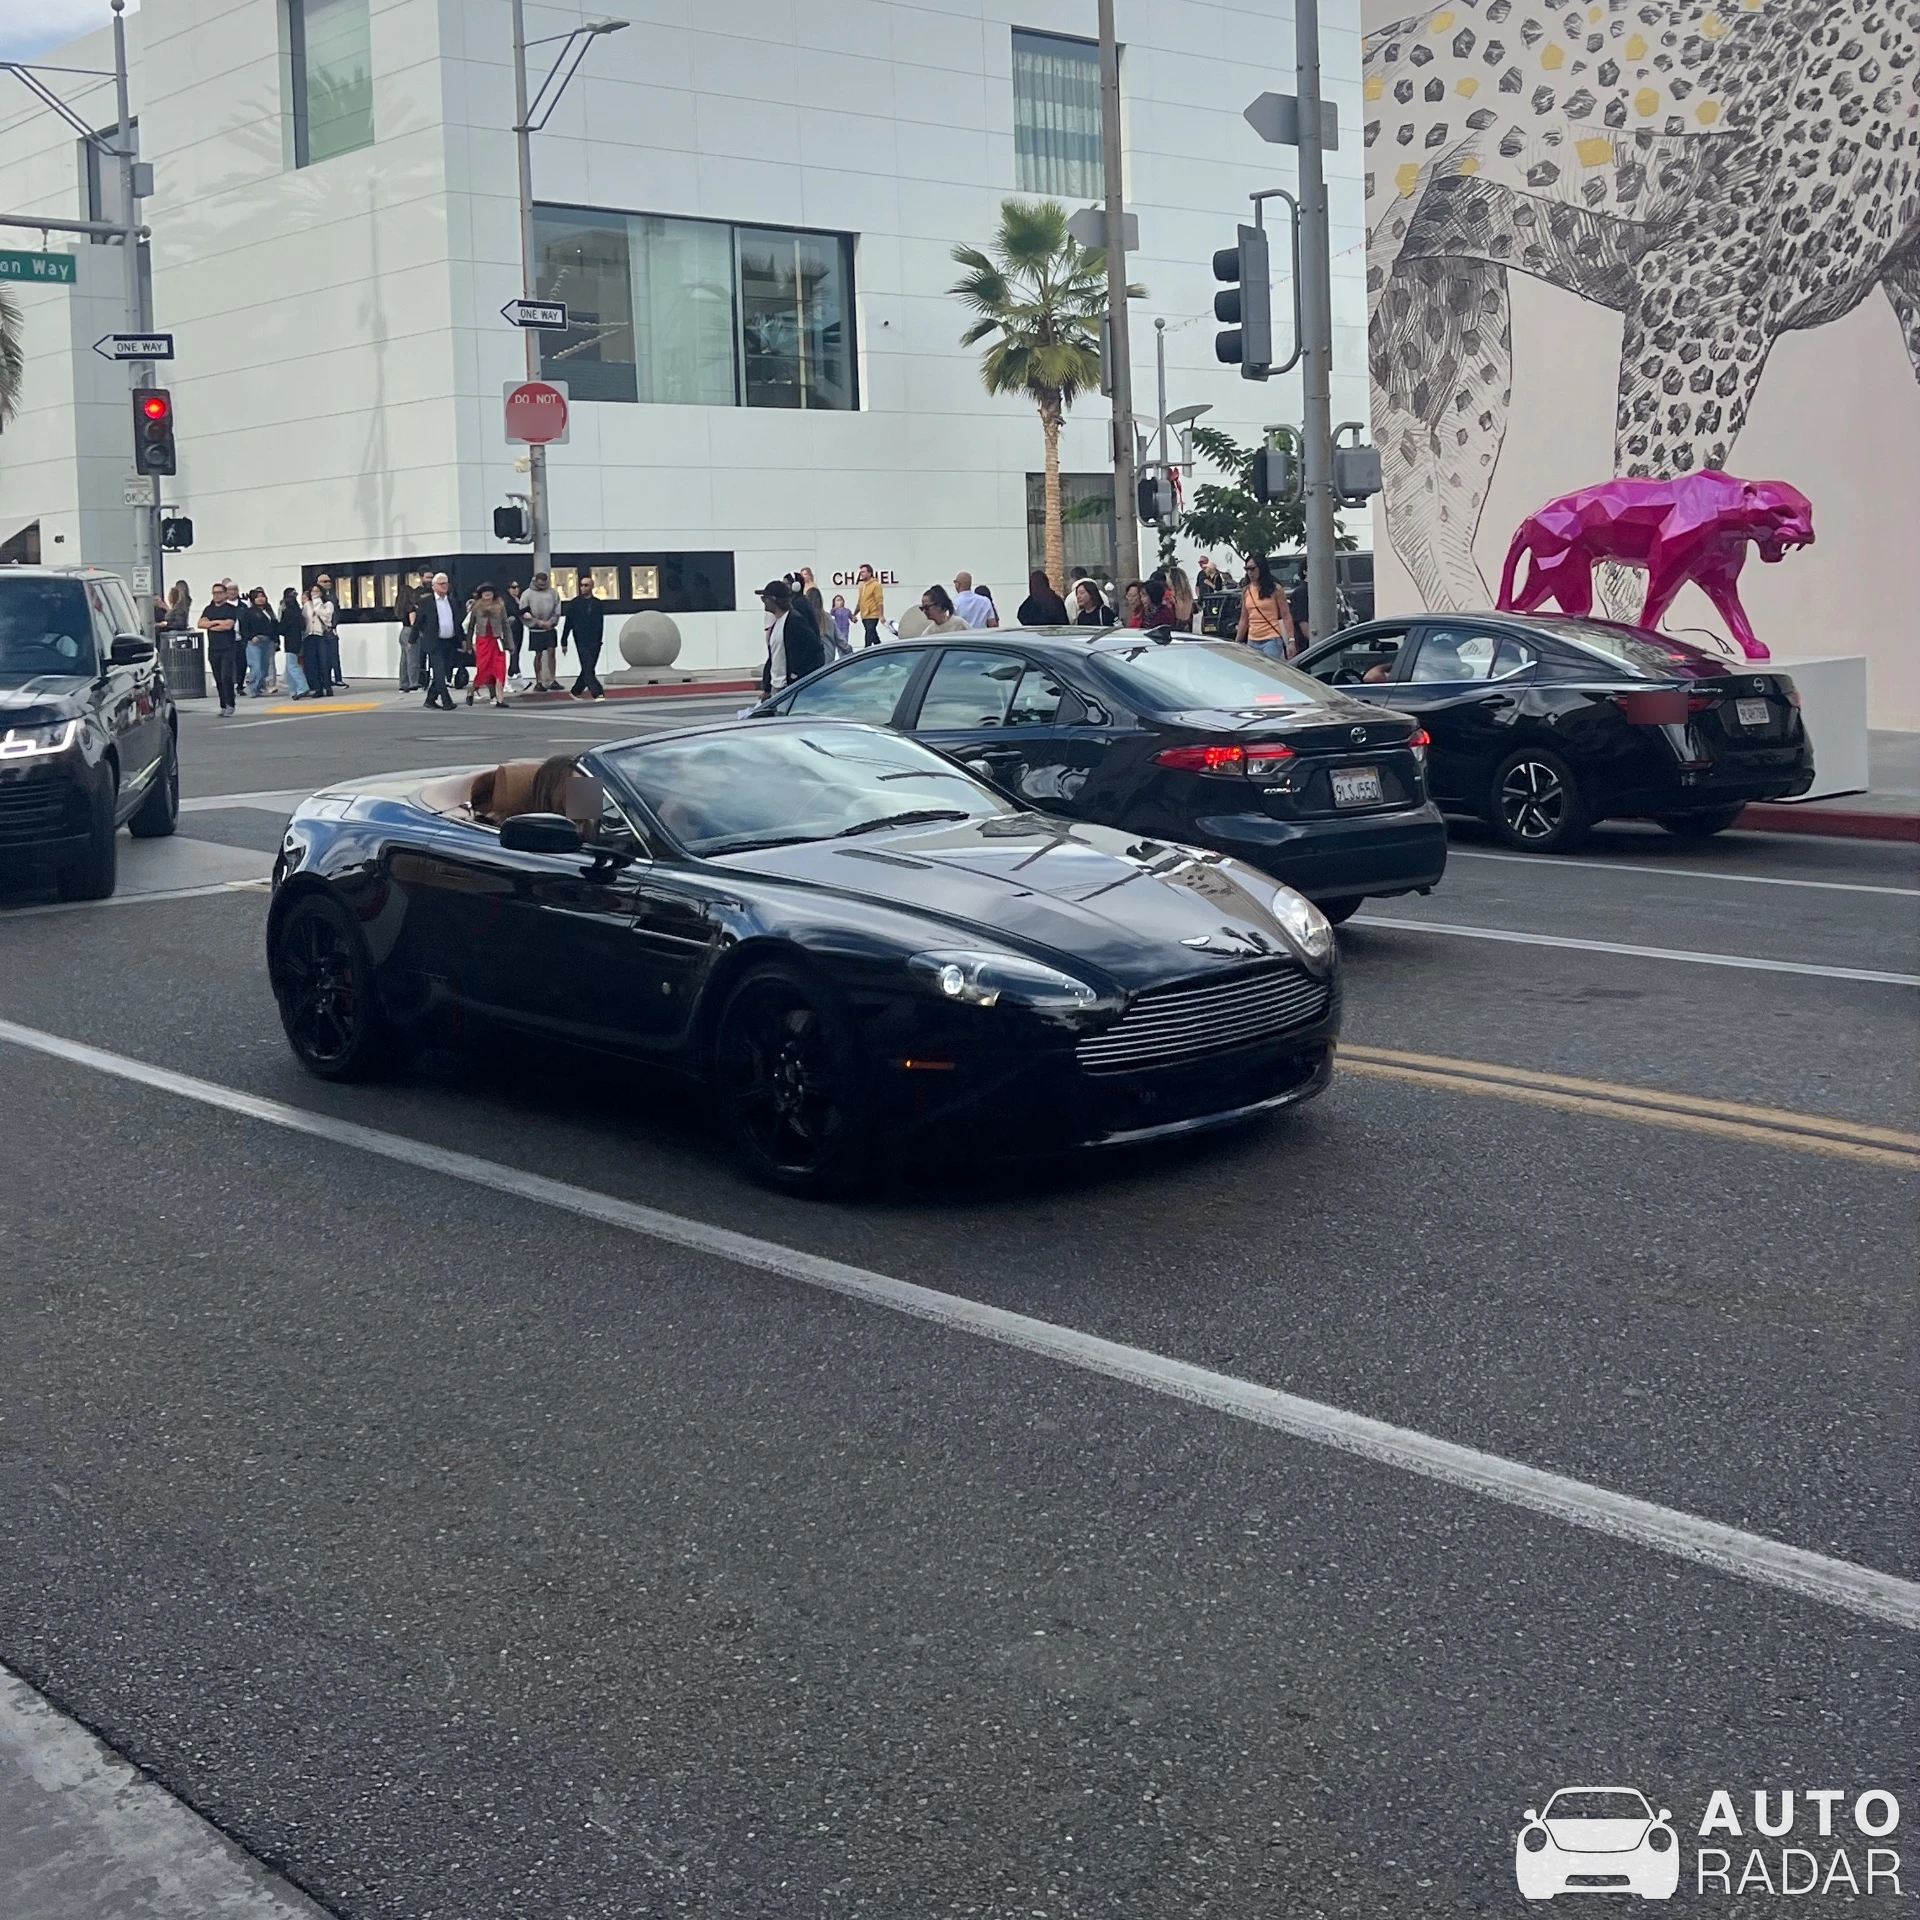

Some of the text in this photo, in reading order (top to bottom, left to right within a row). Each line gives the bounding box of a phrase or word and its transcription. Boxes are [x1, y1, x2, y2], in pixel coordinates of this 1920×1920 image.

[32, 259, 69, 280] Way
[520, 308, 559, 321] ONE WAY
[116, 342, 163, 353] ONE WAY
[515, 393, 558, 404] DO NOT
